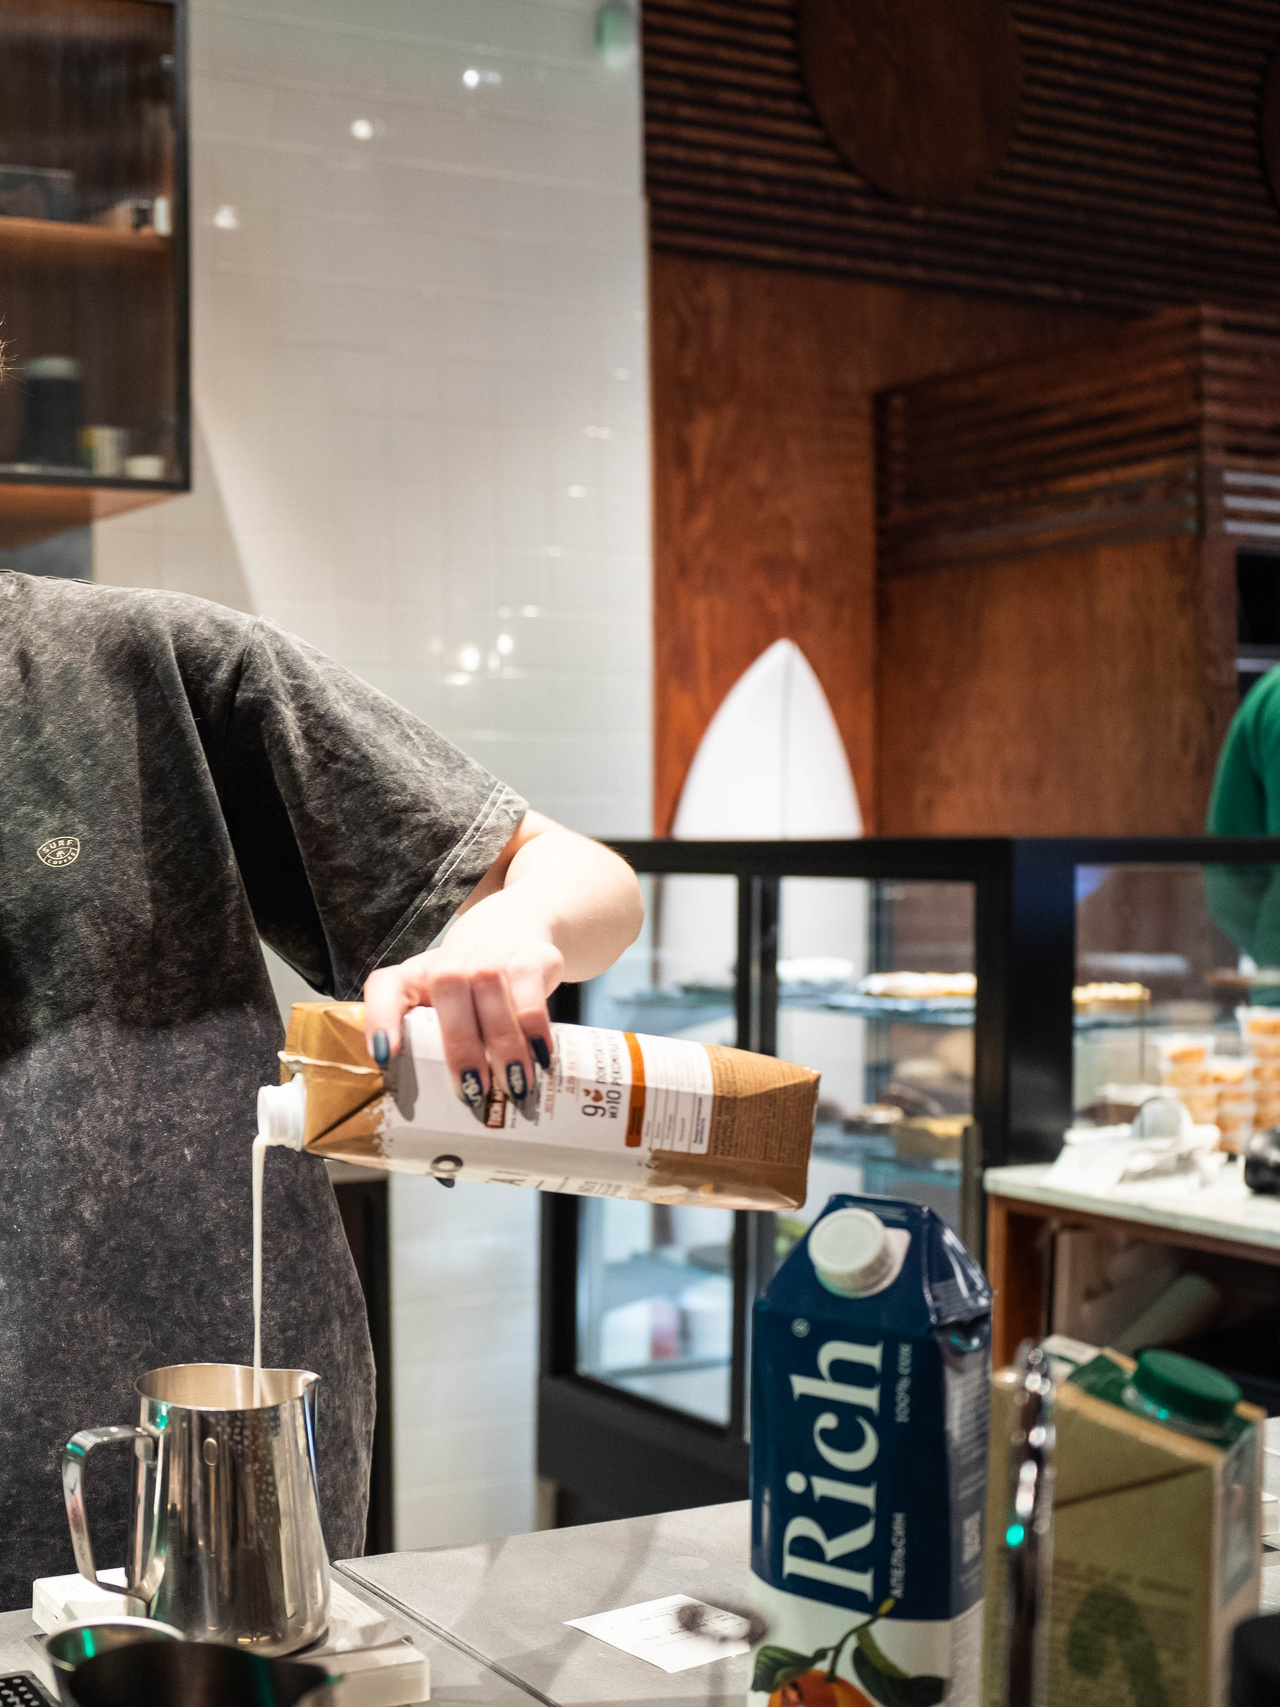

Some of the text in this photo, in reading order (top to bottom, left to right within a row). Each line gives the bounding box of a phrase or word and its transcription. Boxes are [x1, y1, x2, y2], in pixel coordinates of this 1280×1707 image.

[42, 840, 73, 853] SURF
[582, 1105, 606, 1118] 9
[894, 1376, 912, 1423] 100%
[783, 1340, 884, 1601] Rich
[890, 1512, 907, 1599] АПЕЛЬСИН
